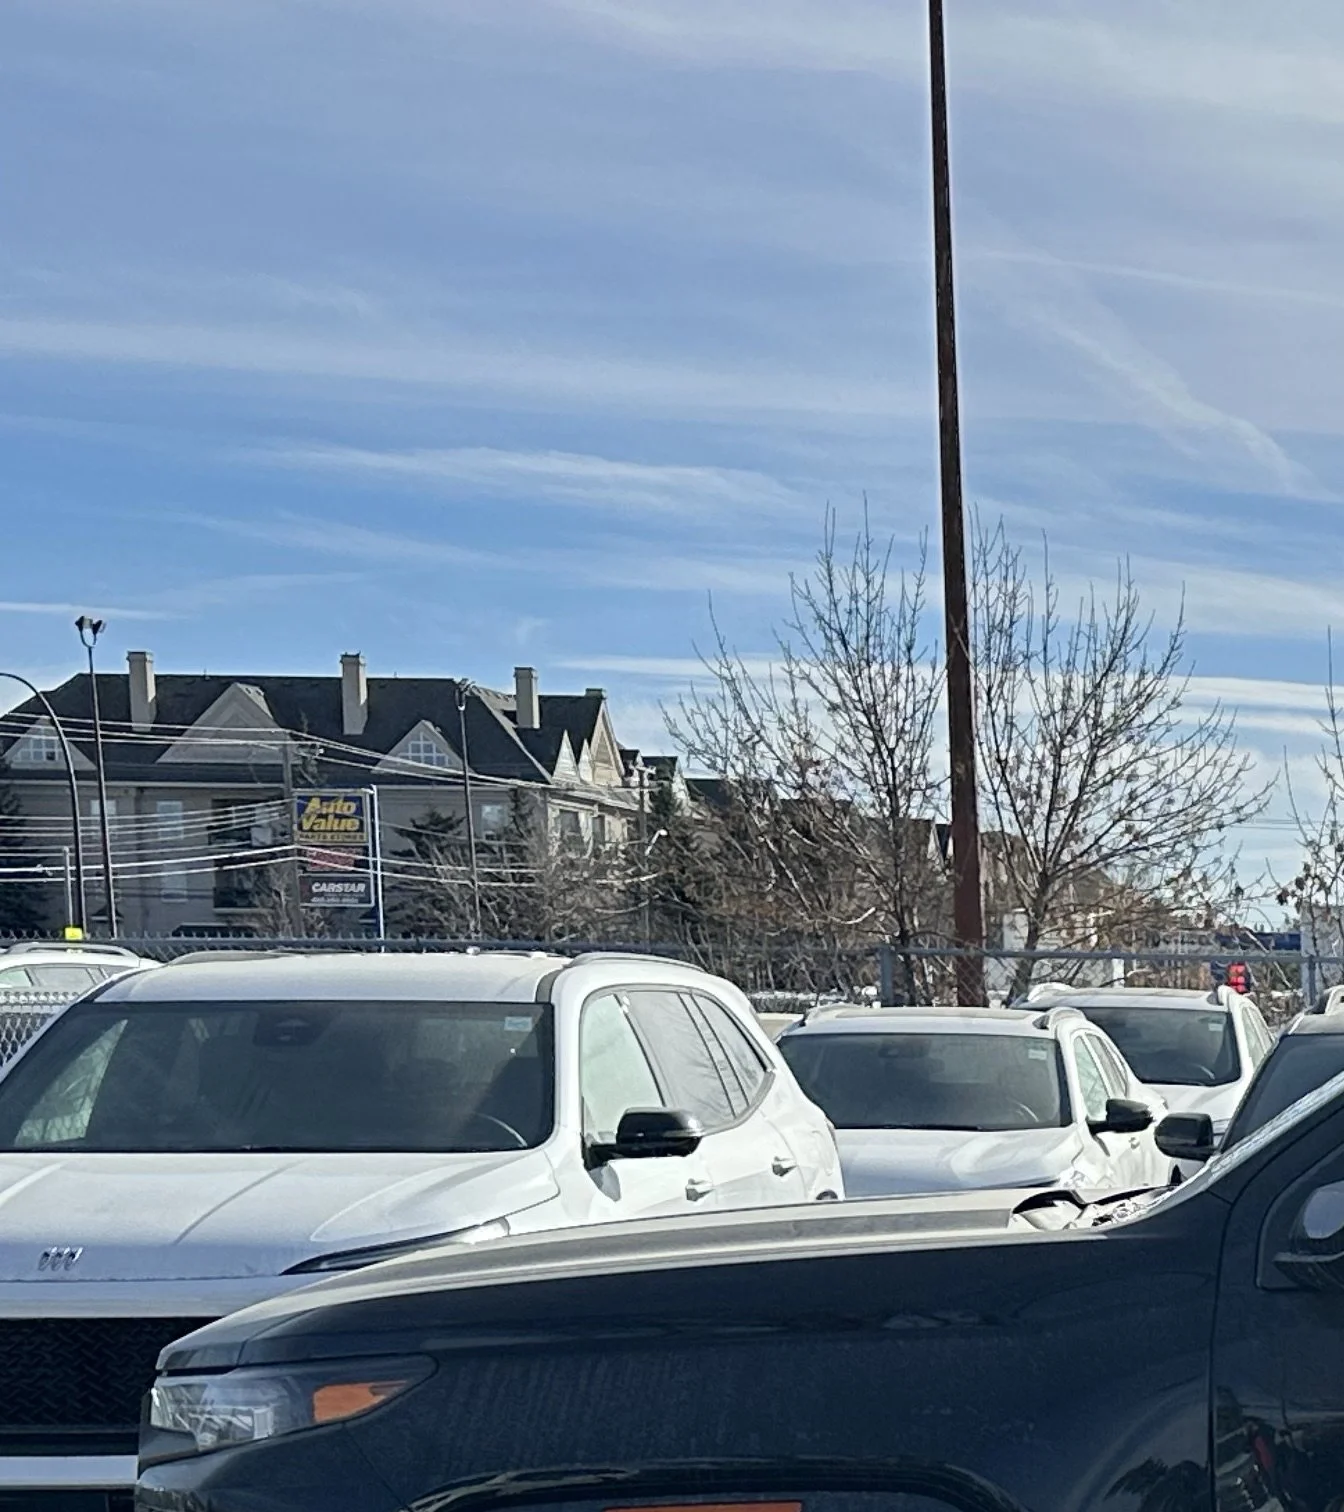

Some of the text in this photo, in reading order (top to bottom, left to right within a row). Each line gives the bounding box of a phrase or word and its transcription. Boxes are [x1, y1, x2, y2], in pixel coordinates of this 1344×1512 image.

[304, 797, 356, 814] Auto
[301, 812, 360, 831] Value
[312, 882, 366, 893] CARSTAR
